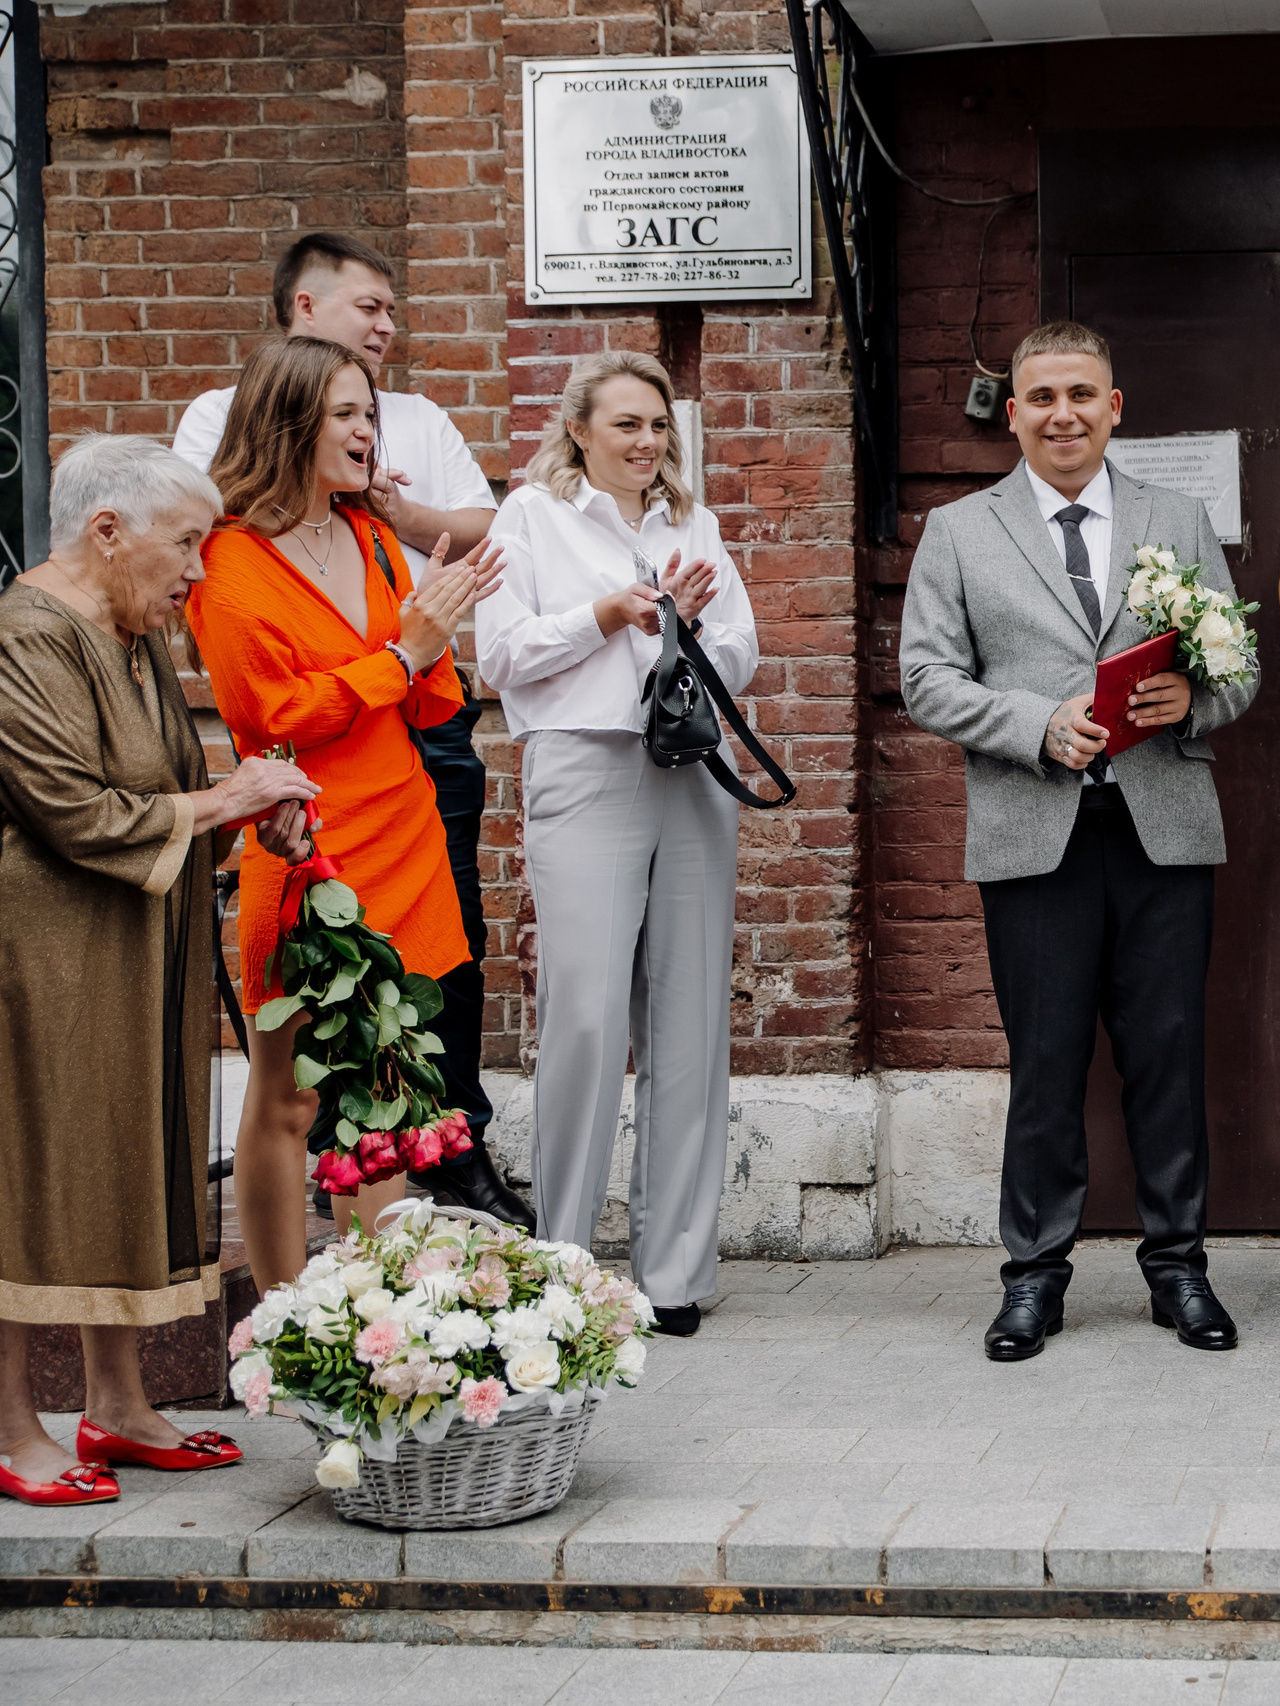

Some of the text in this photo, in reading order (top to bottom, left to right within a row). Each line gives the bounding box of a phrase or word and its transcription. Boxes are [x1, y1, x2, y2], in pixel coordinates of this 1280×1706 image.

[564, 76, 768, 92] РОССИЙСКАЯ ФЕДЕРАЦИЯ
[604, 134, 726, 146] АДМИНИСТРАЦИЯ
[586, 148, 746, 160] ГОРОДА ВЛАДИВОСТОКА
[604, 170, 729, 181] Отдел записи актов
[589, 184, 744, 198] гражданского состояния
[584, 199, 751, 213] по Первомайскому району
[616, 216, 718, 248] ЗАГС
[544, 256, 792, 271] 690021, г.Владивосток, ул.Гульбиновича, д.3
[596, 270, 739, 282] тел. 227-78-20; 227-86-32
